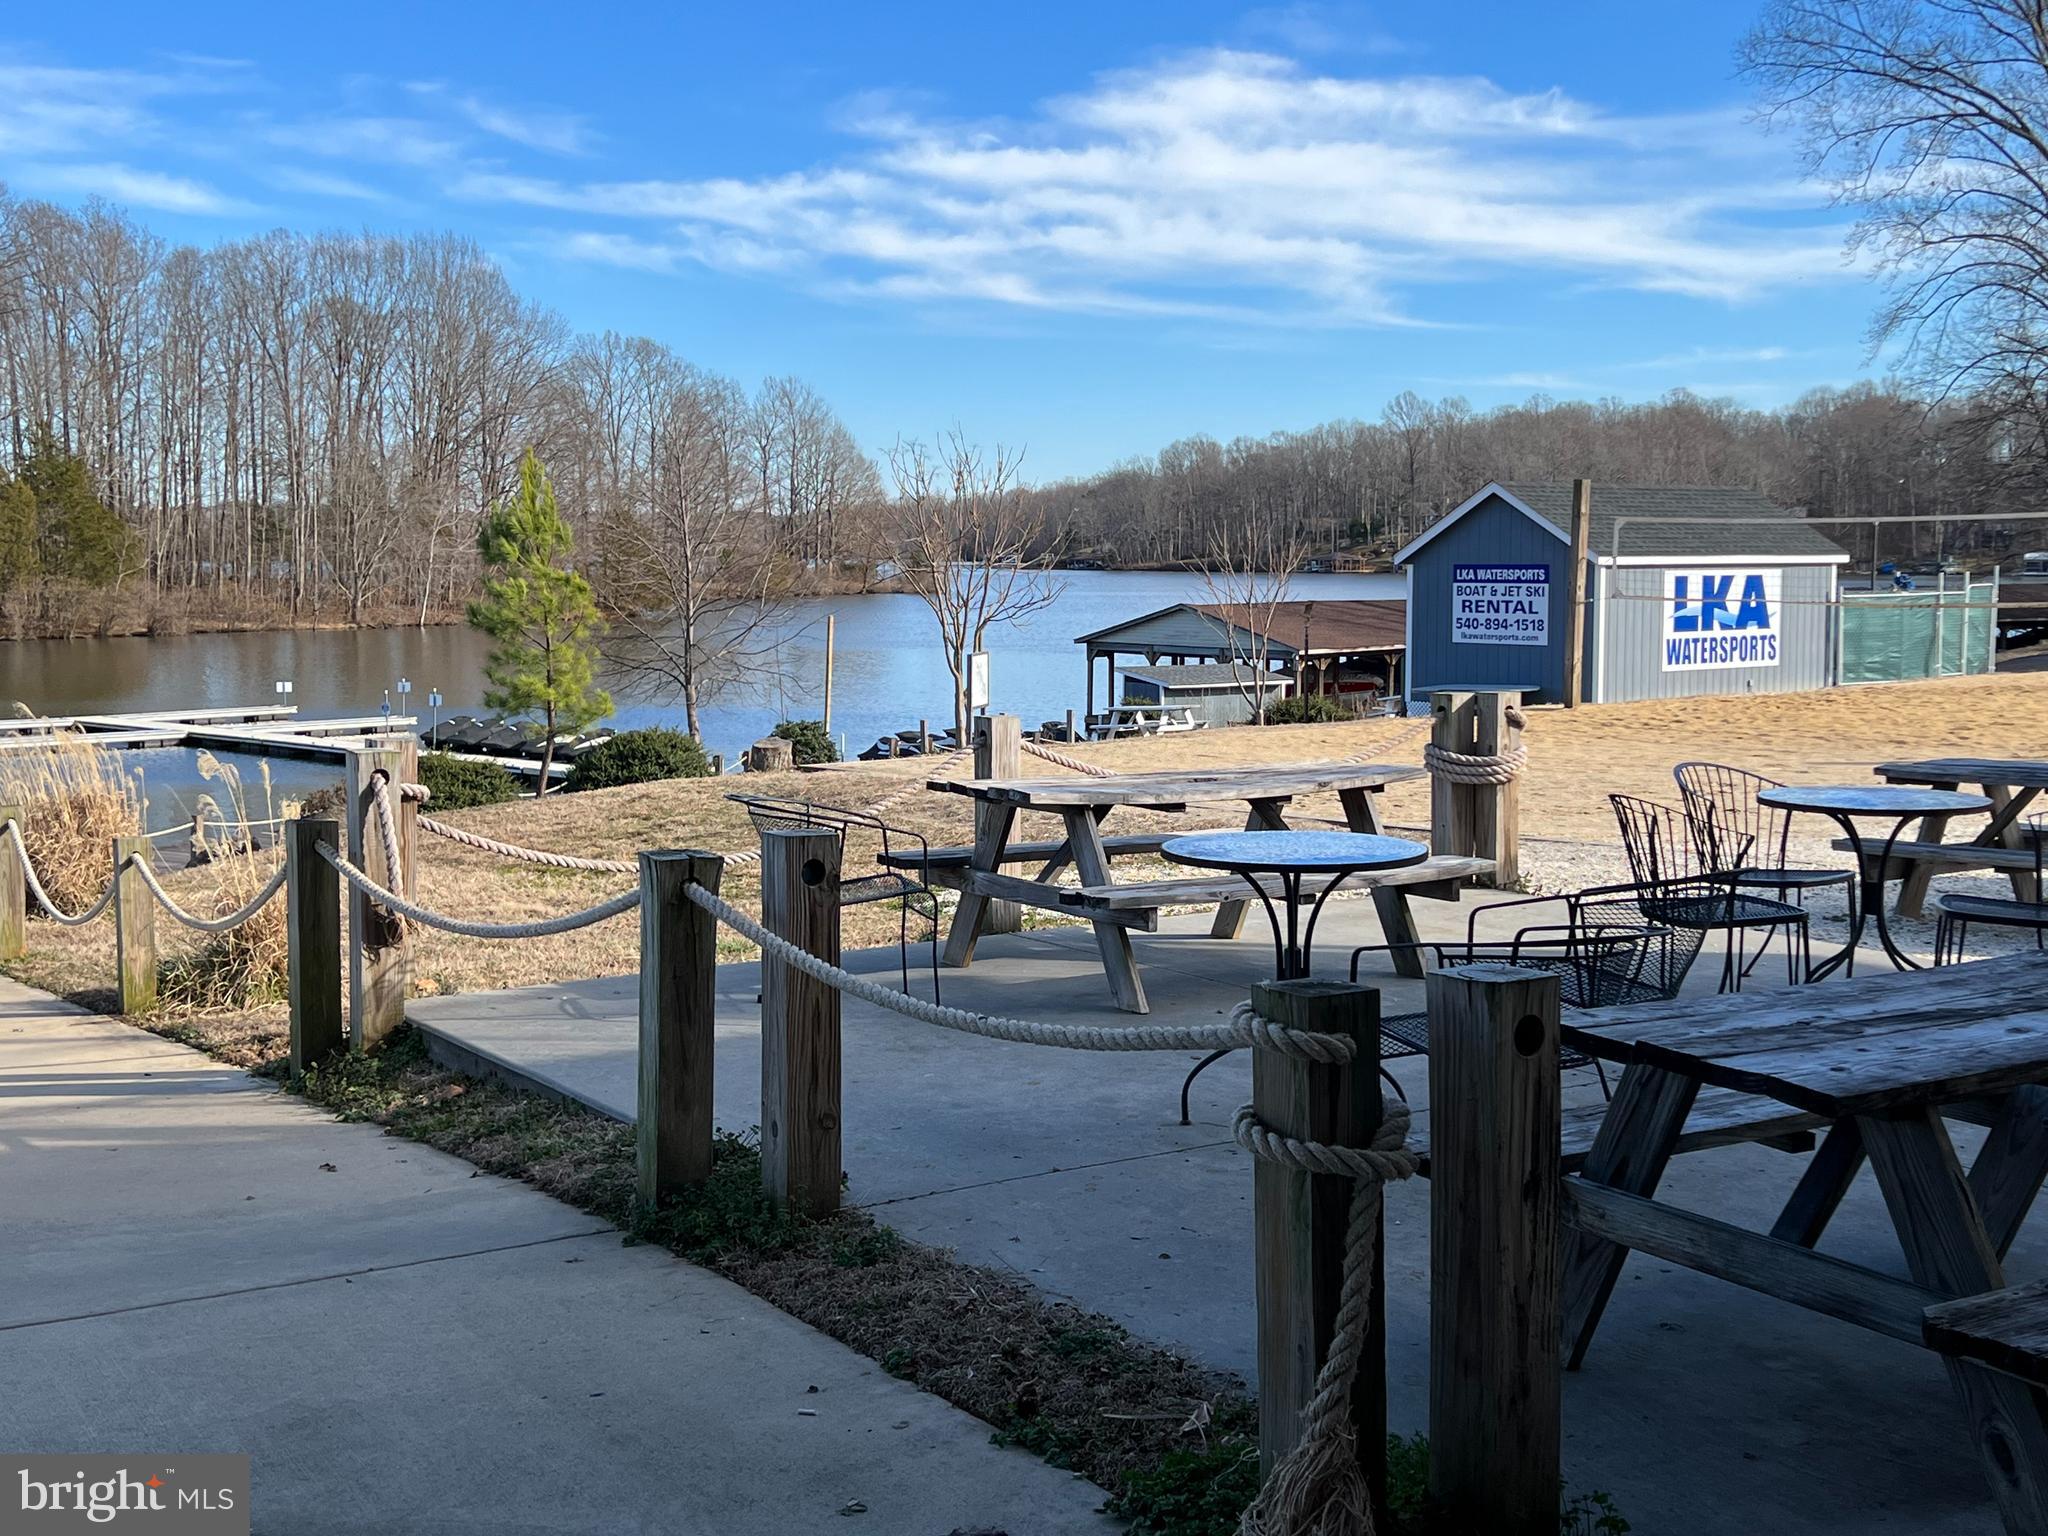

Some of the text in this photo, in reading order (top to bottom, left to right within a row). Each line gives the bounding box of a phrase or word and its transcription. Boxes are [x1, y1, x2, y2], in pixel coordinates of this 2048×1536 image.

[1456, 569, 1545, 580] LKA WATERSPORTS
[1456, 585, 1545, 597] BOAT & JET SKI
[1461, 600, 1539, 614] RENTAL
[1673, 575, 1770, 632] LKA
[1456, 618, 1545, 631] 540-894-1518
[1461, 632, 1539, 642] lkawatersports.com
[1666, 634, 1776, 665] WATERSPORTS
